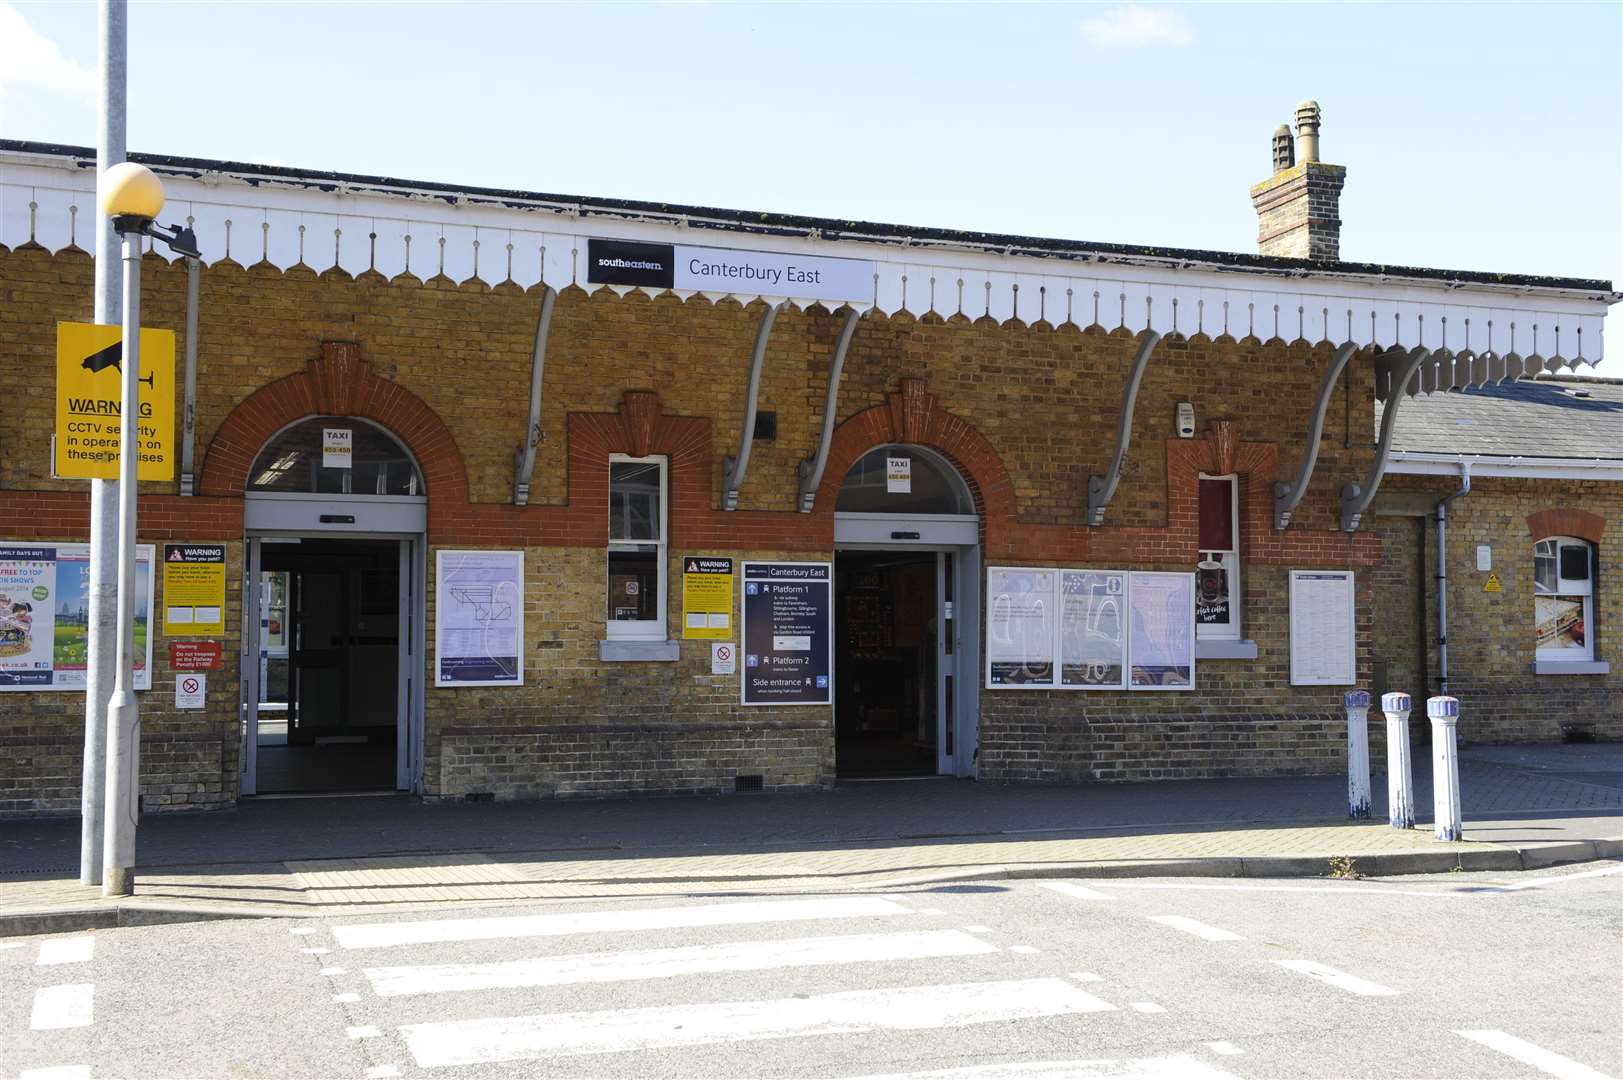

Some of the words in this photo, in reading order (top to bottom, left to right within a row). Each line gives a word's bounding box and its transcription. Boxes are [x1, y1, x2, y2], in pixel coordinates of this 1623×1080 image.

[689, 259, 781, 285] Canterbury
[787, 267, 821, 284] East
[68, 398, 152, 416] WARNG
[68, 422, 102, 433] CCTV
[326, 432, 349, 440] TAXI
[67, 435, 78, 447] in
[146, 441, 161, 449] on
[68, 449, 104, 461] these
[107, 452, 164, 463] prises
[184, 548, 221, 556] WARNING
[771, 568, 809, 578] Canterbury
[810, 569, 825, 577] East
[773, 585, 803, 593] Platform
[773, 656, 803, 665] Platform
[804, 656, 810, 665] 2
[753, 678, 769, 686] Side
[770, 678, 802, 686] entrance
